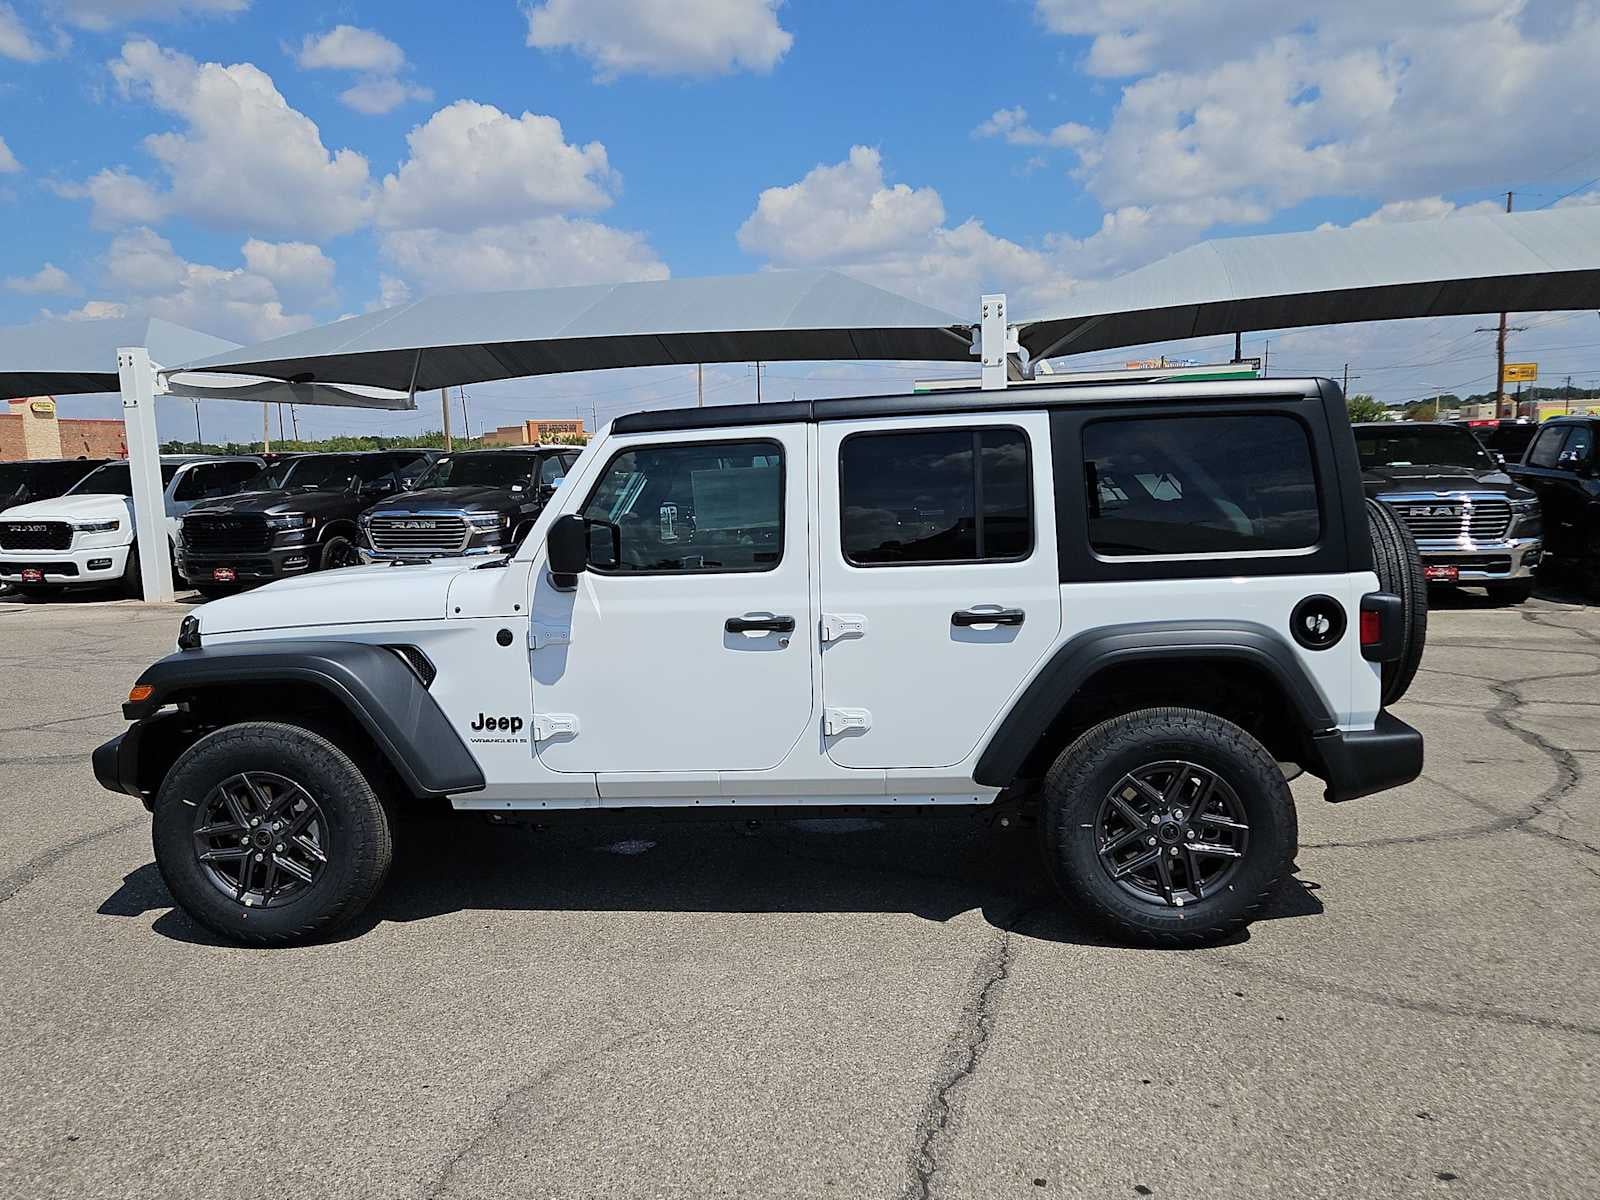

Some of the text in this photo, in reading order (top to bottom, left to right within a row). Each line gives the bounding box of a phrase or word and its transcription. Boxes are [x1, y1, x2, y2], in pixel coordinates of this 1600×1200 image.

[1409, 507, 1476, 516] RAM
[391, 521, 436, 529] RAM
[471, 712, 523, 734] Jeep
